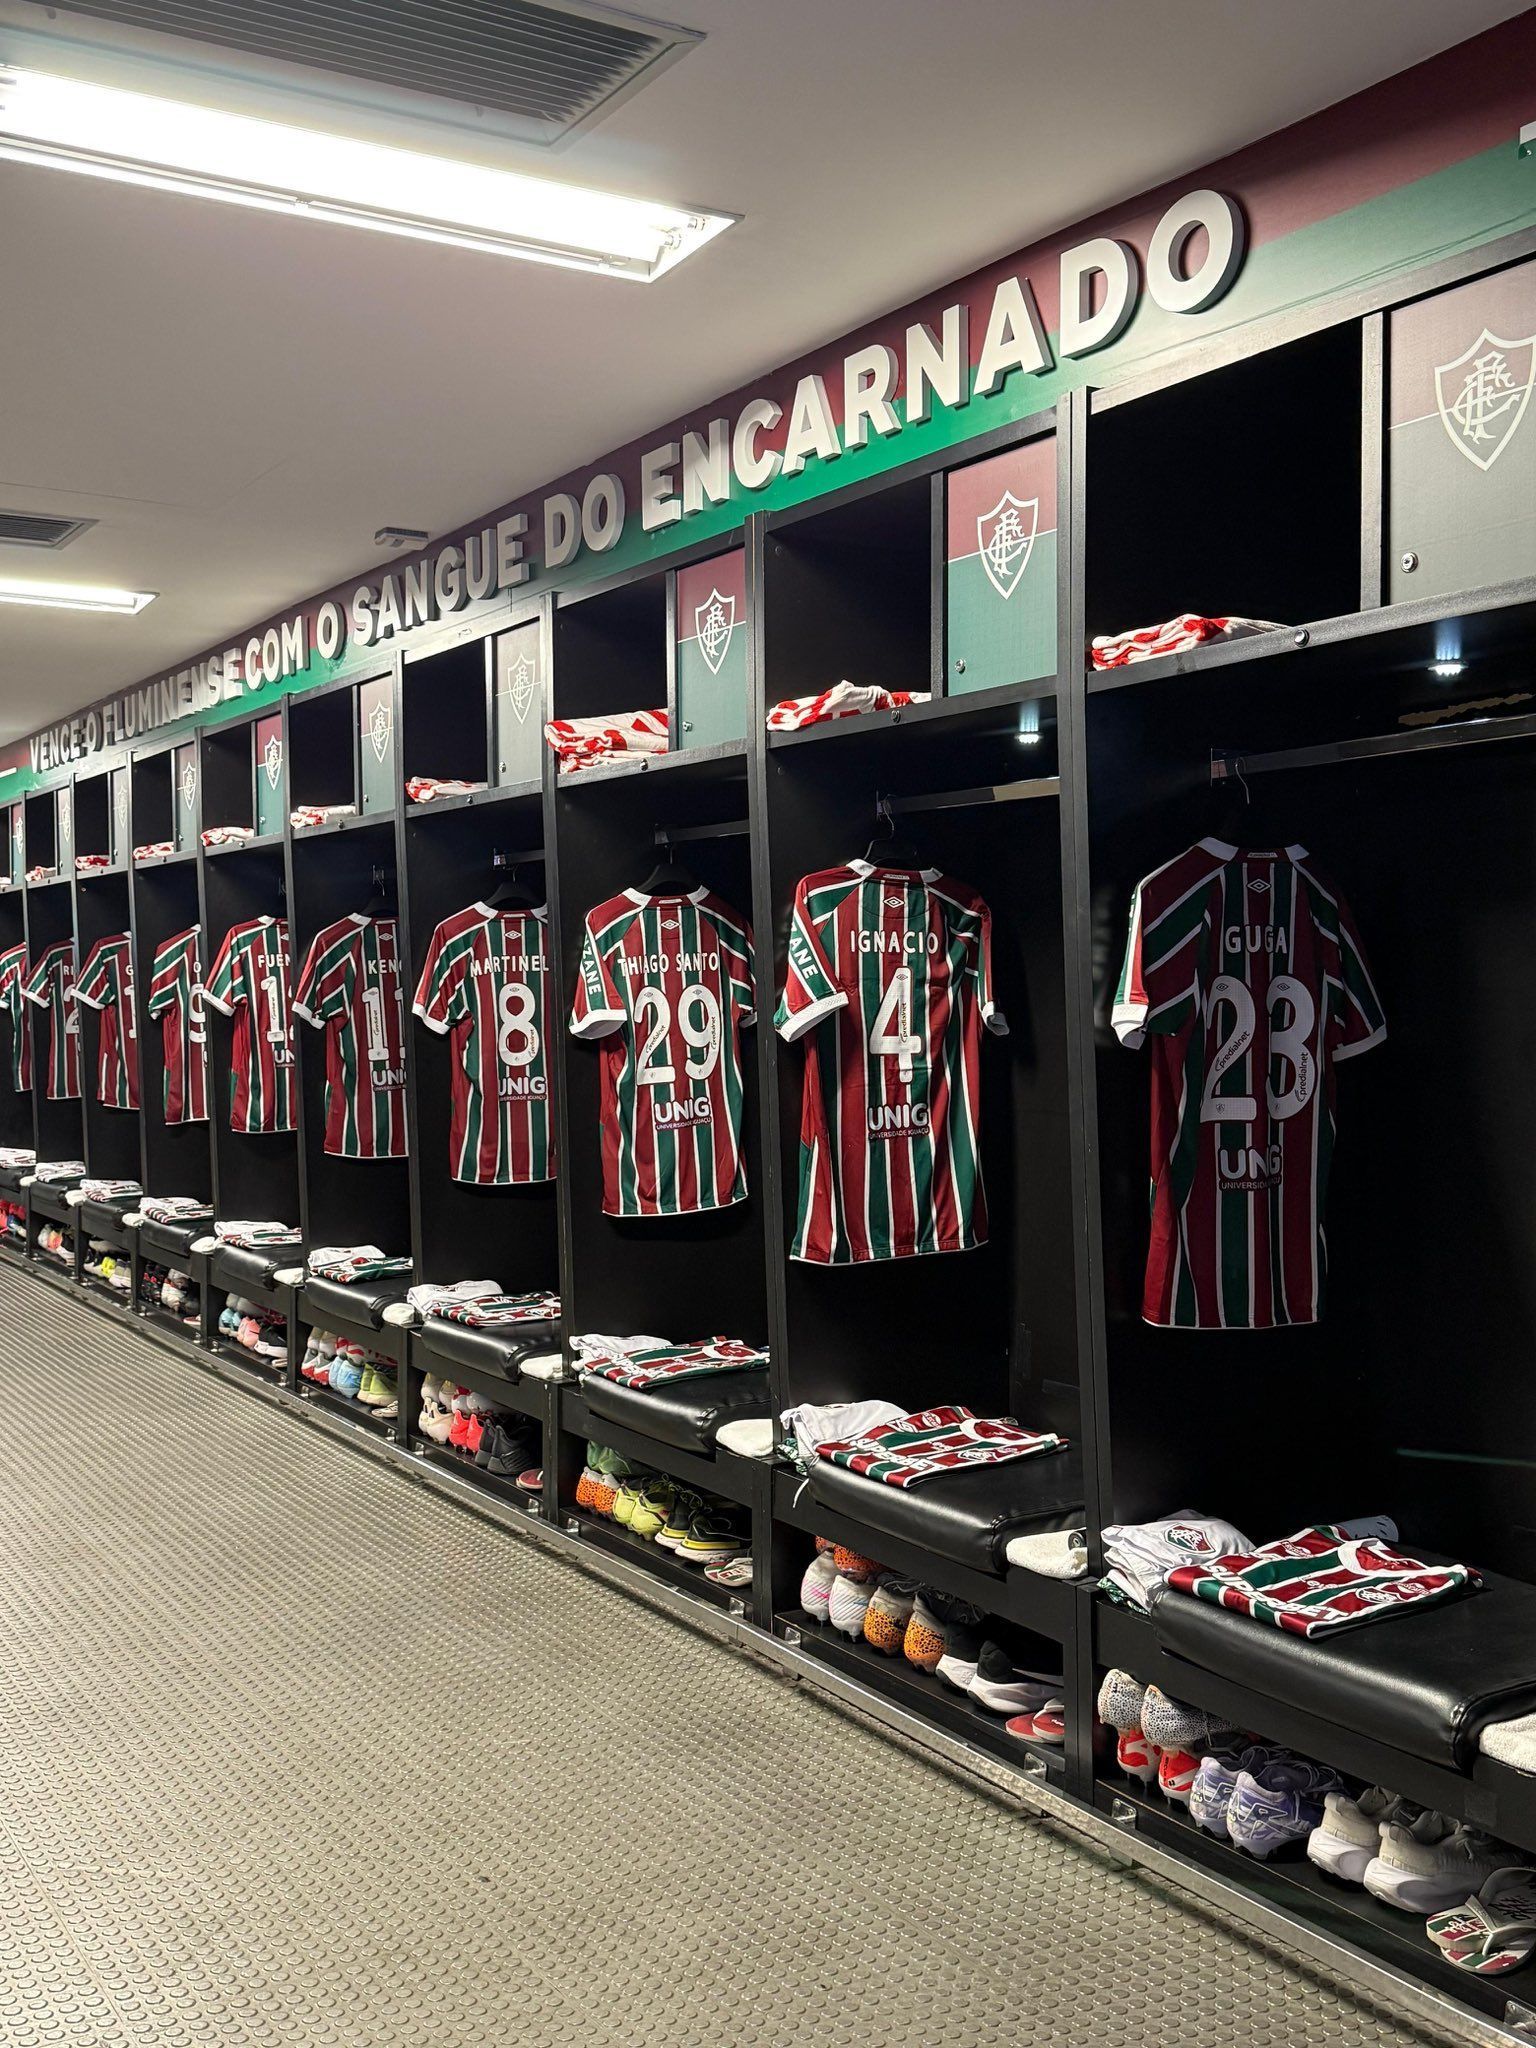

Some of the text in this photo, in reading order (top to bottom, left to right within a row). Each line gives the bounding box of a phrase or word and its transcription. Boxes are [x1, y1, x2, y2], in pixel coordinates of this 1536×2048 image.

[29, 189, 1245, 775] VENCE O FLUMINENSE COM O SANGUE DO ENCARNADO
[850, 930, 938, 954] IGNACIO
[1225, 925, 1288, 954] GUGA
[617, 952, 669, 977] THIAGO
[498, 982, 540, 1067] 8
[633, 984, 721, 1086] 29
[870, 967, 922, 1083] 4
[1200, 975, 1316, 1123] 23
[1216, 1030, 1251, 1072] predialnet
[1298, 1052, 1309, 1100] predialnet
[655, 1096, 711, 1123] UNIG
[868, 1103, 929, 1130] UNIG
